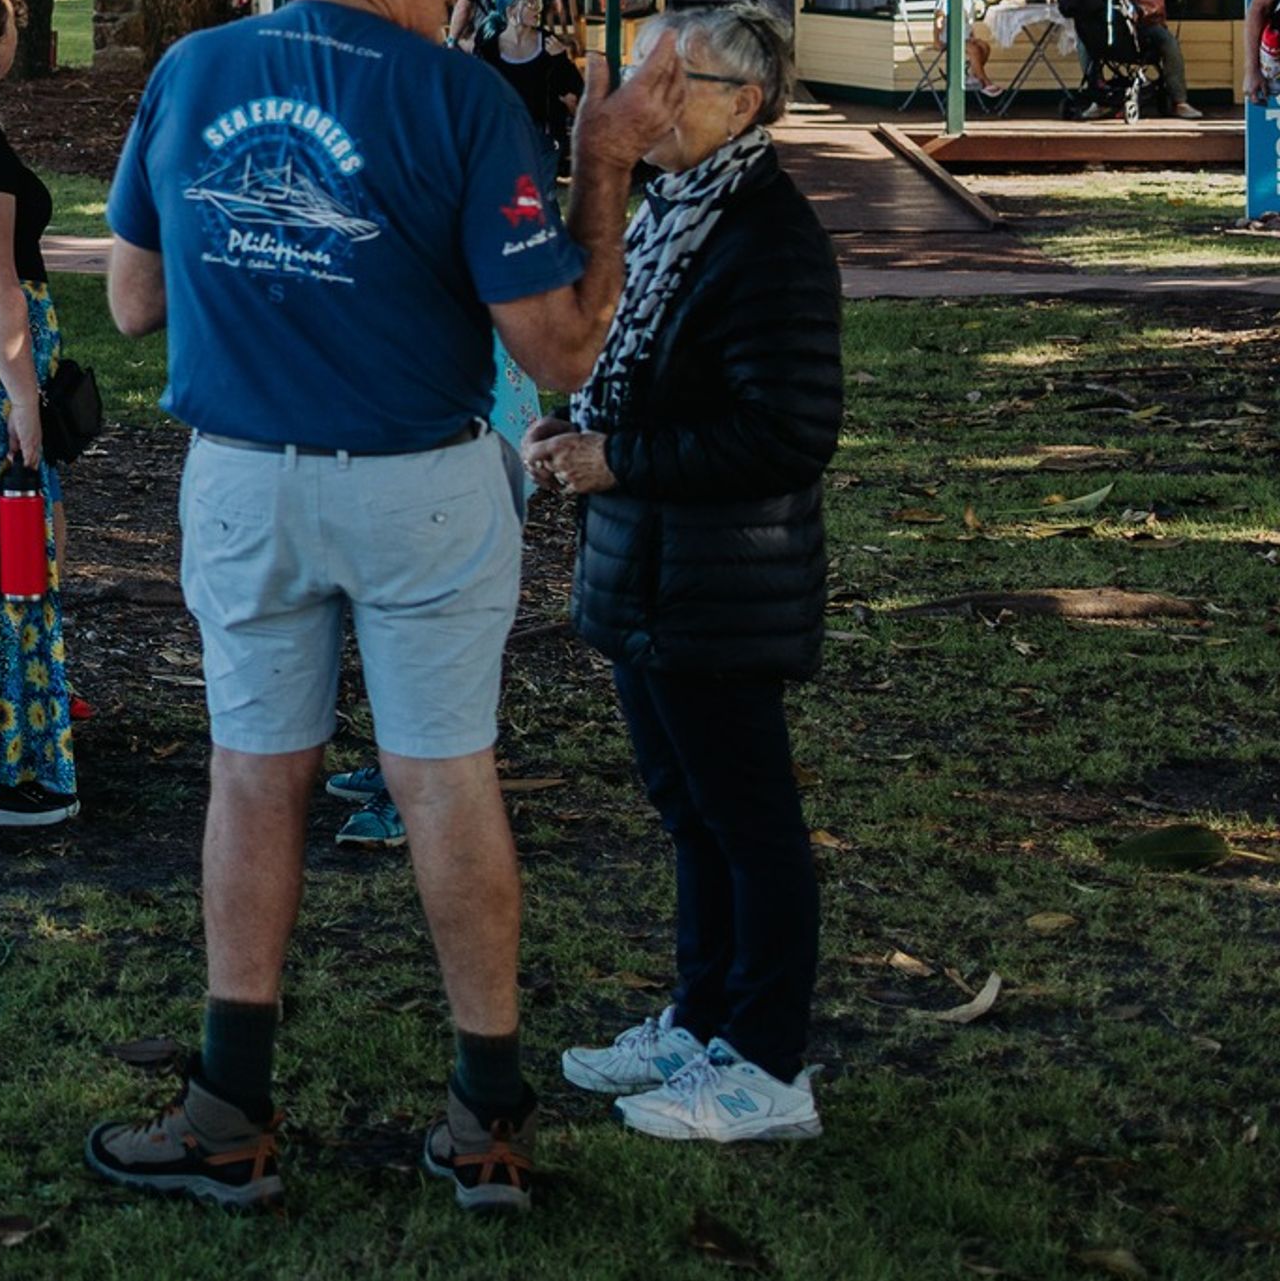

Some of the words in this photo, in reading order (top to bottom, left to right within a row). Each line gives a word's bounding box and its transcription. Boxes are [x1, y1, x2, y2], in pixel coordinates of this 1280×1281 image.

[203, 107, 248, 148] SEA
[250, 98, 361, 175] EXPLORERS
[228, 228, 332, 265] Philippines
[716, 1087, 759, 1119] N
